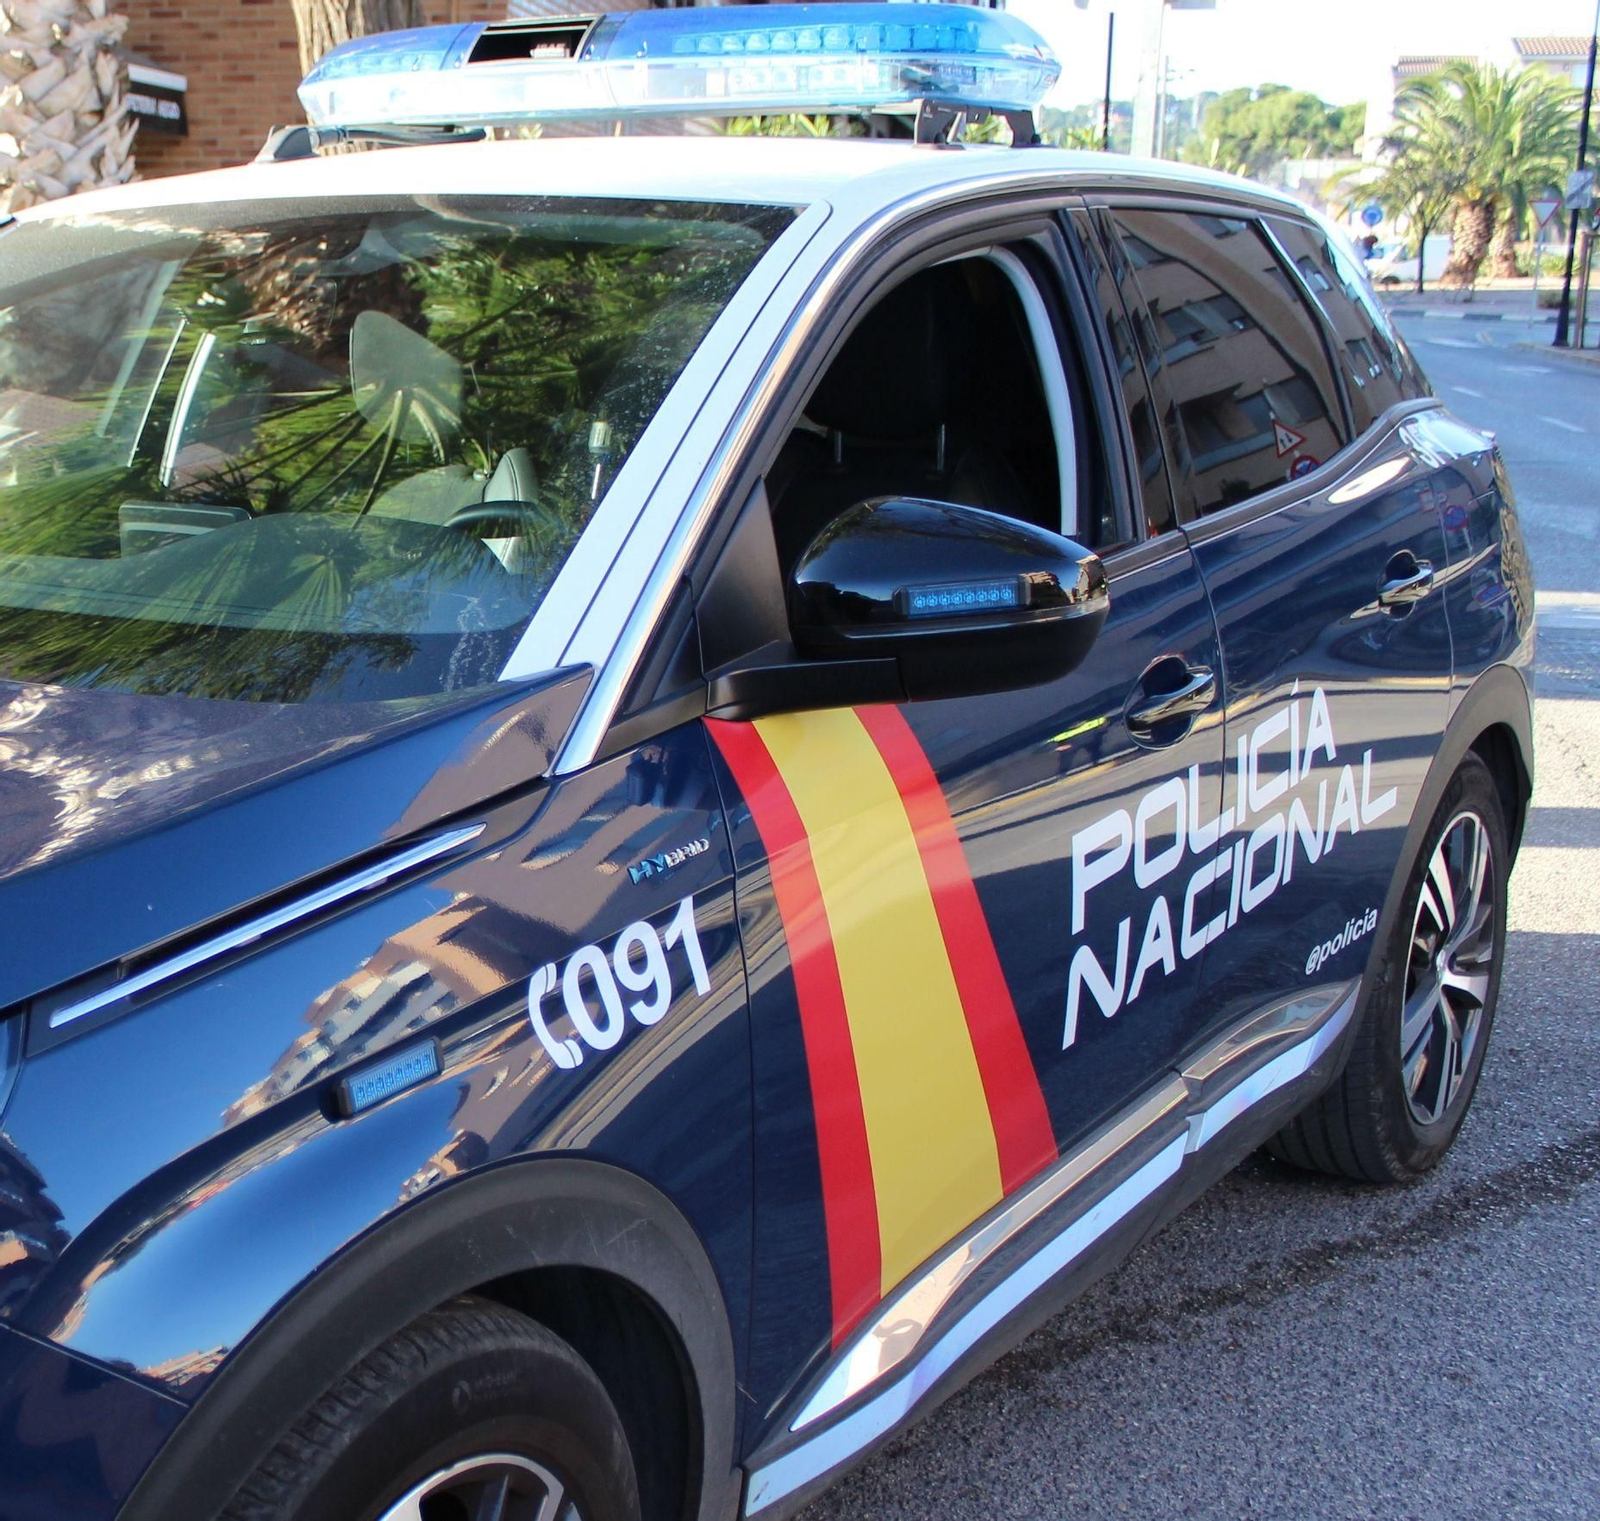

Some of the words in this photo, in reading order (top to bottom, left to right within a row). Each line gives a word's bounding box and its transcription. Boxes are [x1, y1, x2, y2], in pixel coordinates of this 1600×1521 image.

[628, 838, 710, 885] HYBRID
[1062, 749, 1397, 1050] NACIONAL
[1072, 678, 1337, 935] POLICÍA
[563, 896, 711, 1050] 091
